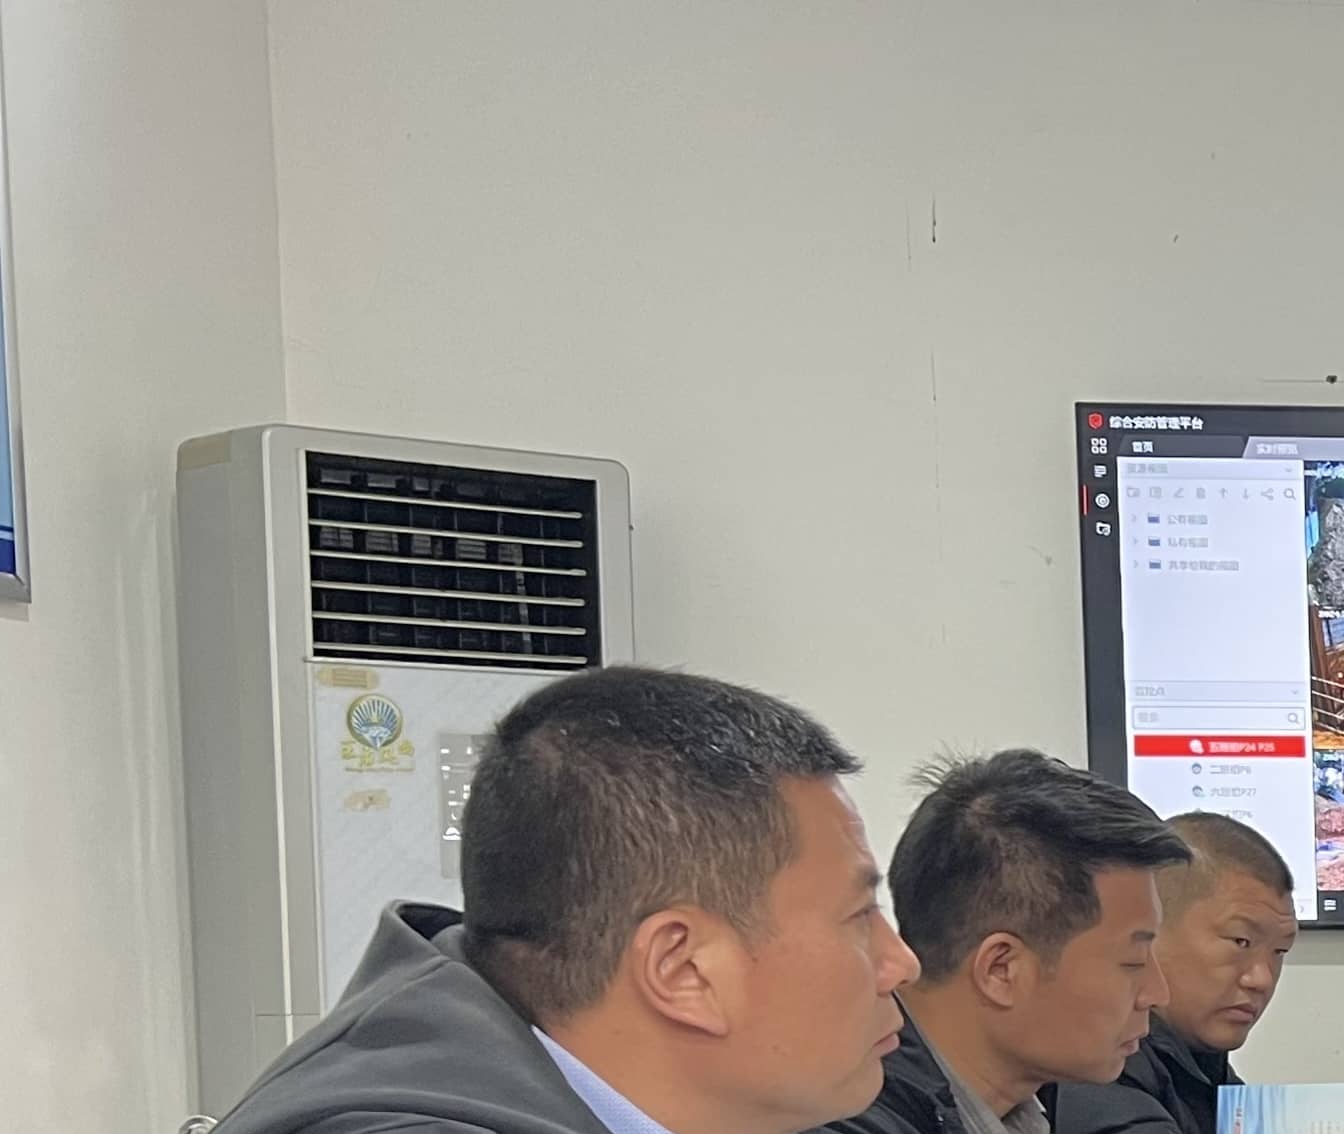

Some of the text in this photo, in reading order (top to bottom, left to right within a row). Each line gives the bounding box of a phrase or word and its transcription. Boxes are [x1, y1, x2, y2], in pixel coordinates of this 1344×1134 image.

[1109, 416, 1204, 431] 综合安防管理平台
[1131, 441, 1154, 454] 首页
